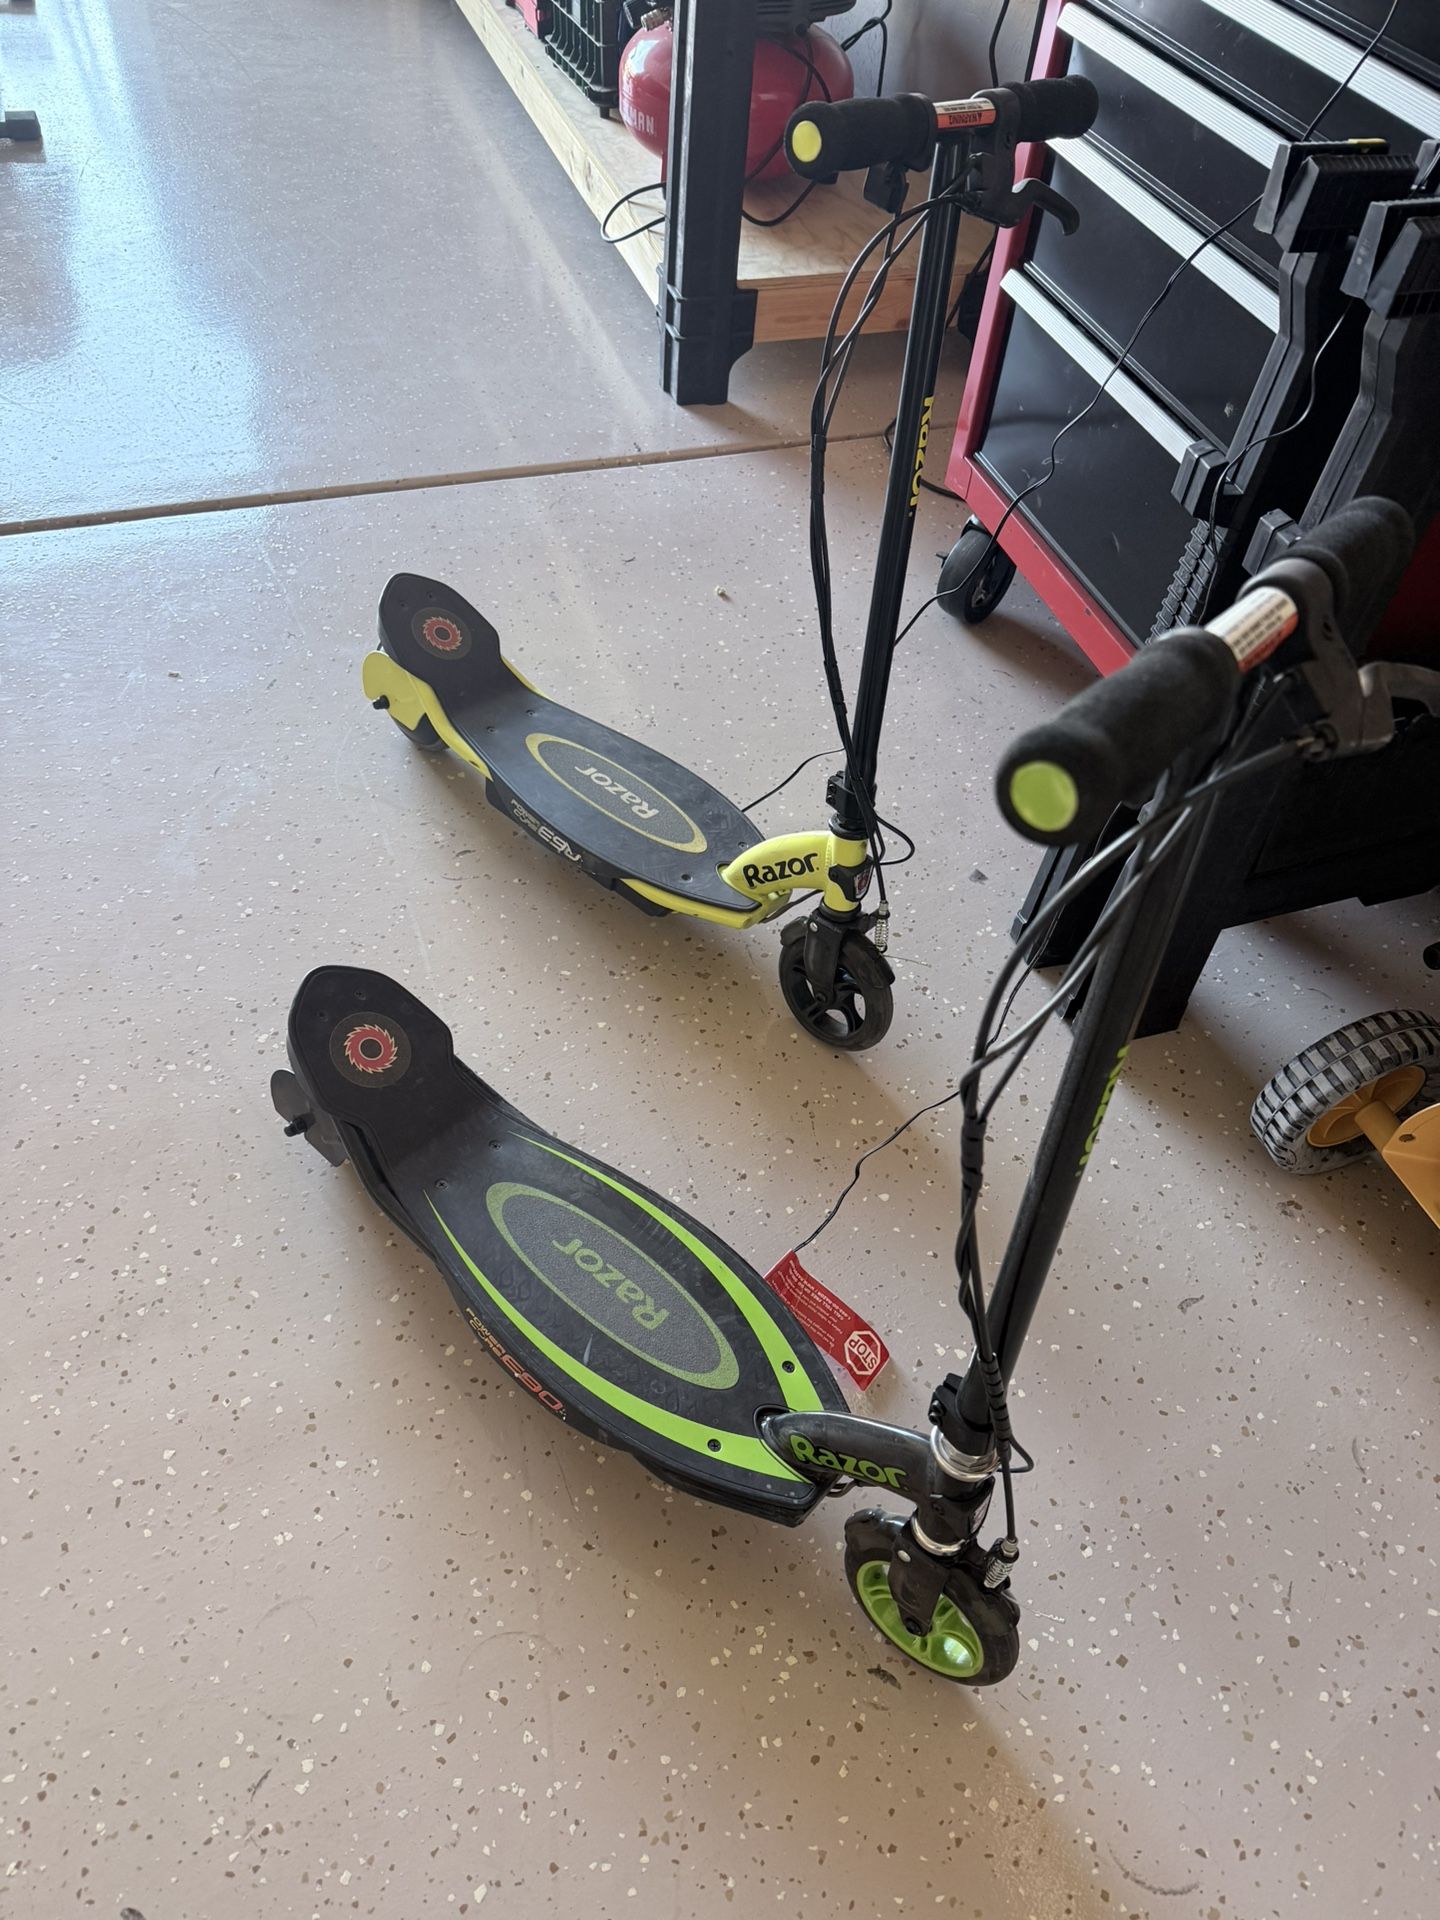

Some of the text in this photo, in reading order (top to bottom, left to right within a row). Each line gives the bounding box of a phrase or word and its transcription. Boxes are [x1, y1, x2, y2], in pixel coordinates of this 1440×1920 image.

[574, 764, 659, 819] Razor
[743, 853, 818, 889] Razor
[552, 1239, 670, 1329] Razor
[466, 1307, 506, 1354] POWER
[849, 1338, 877, 1370] STOP
[501, 1354, 563, 1410] E90
[790, 1434, 906, 1488] Razor
